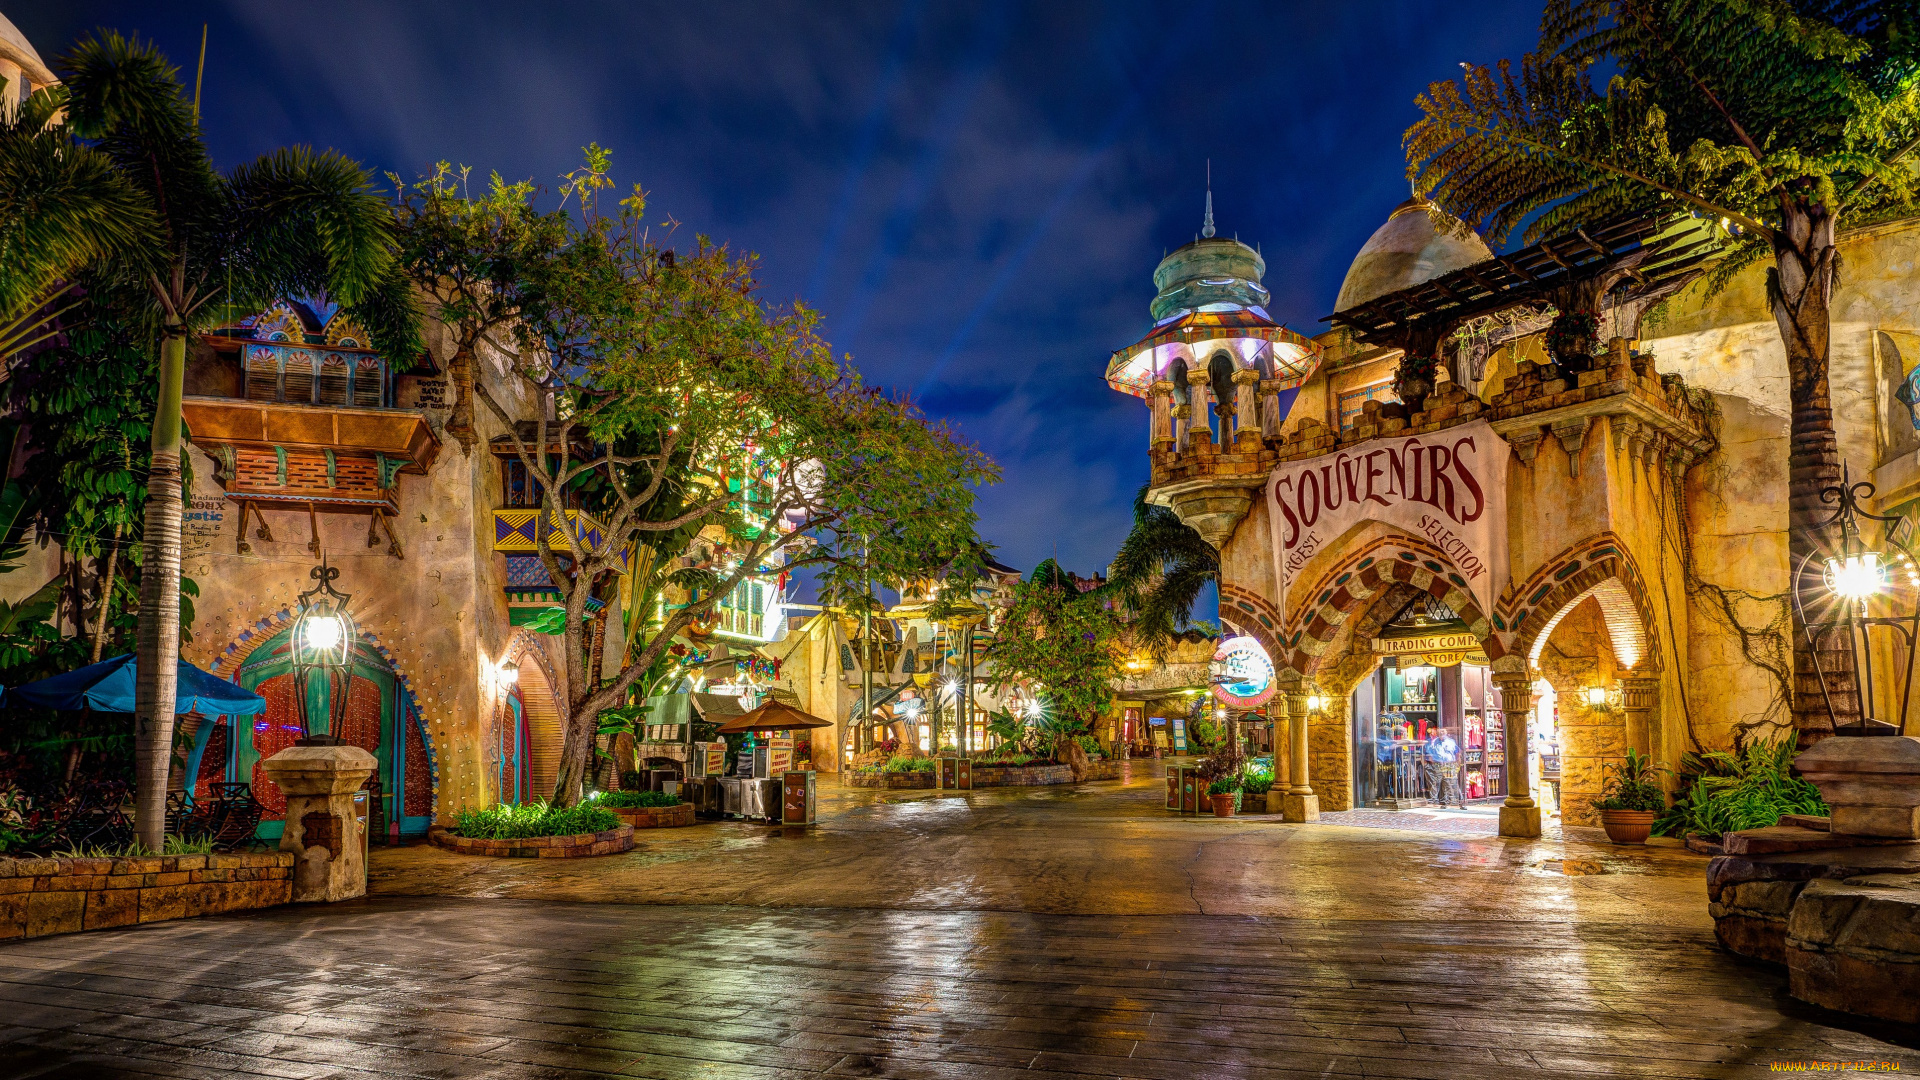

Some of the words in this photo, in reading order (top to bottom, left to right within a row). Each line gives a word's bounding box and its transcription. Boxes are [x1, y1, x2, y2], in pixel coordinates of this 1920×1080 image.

[1275, 436, 1485, 549] SOUVENIRS
[1417, 514, 1487, 581] SELECTION
[1387, 638, 1435, 652] TRADING
[1426, 652, 1461, 664] STORE
[1215, 685, 1243, 707] TRADING
